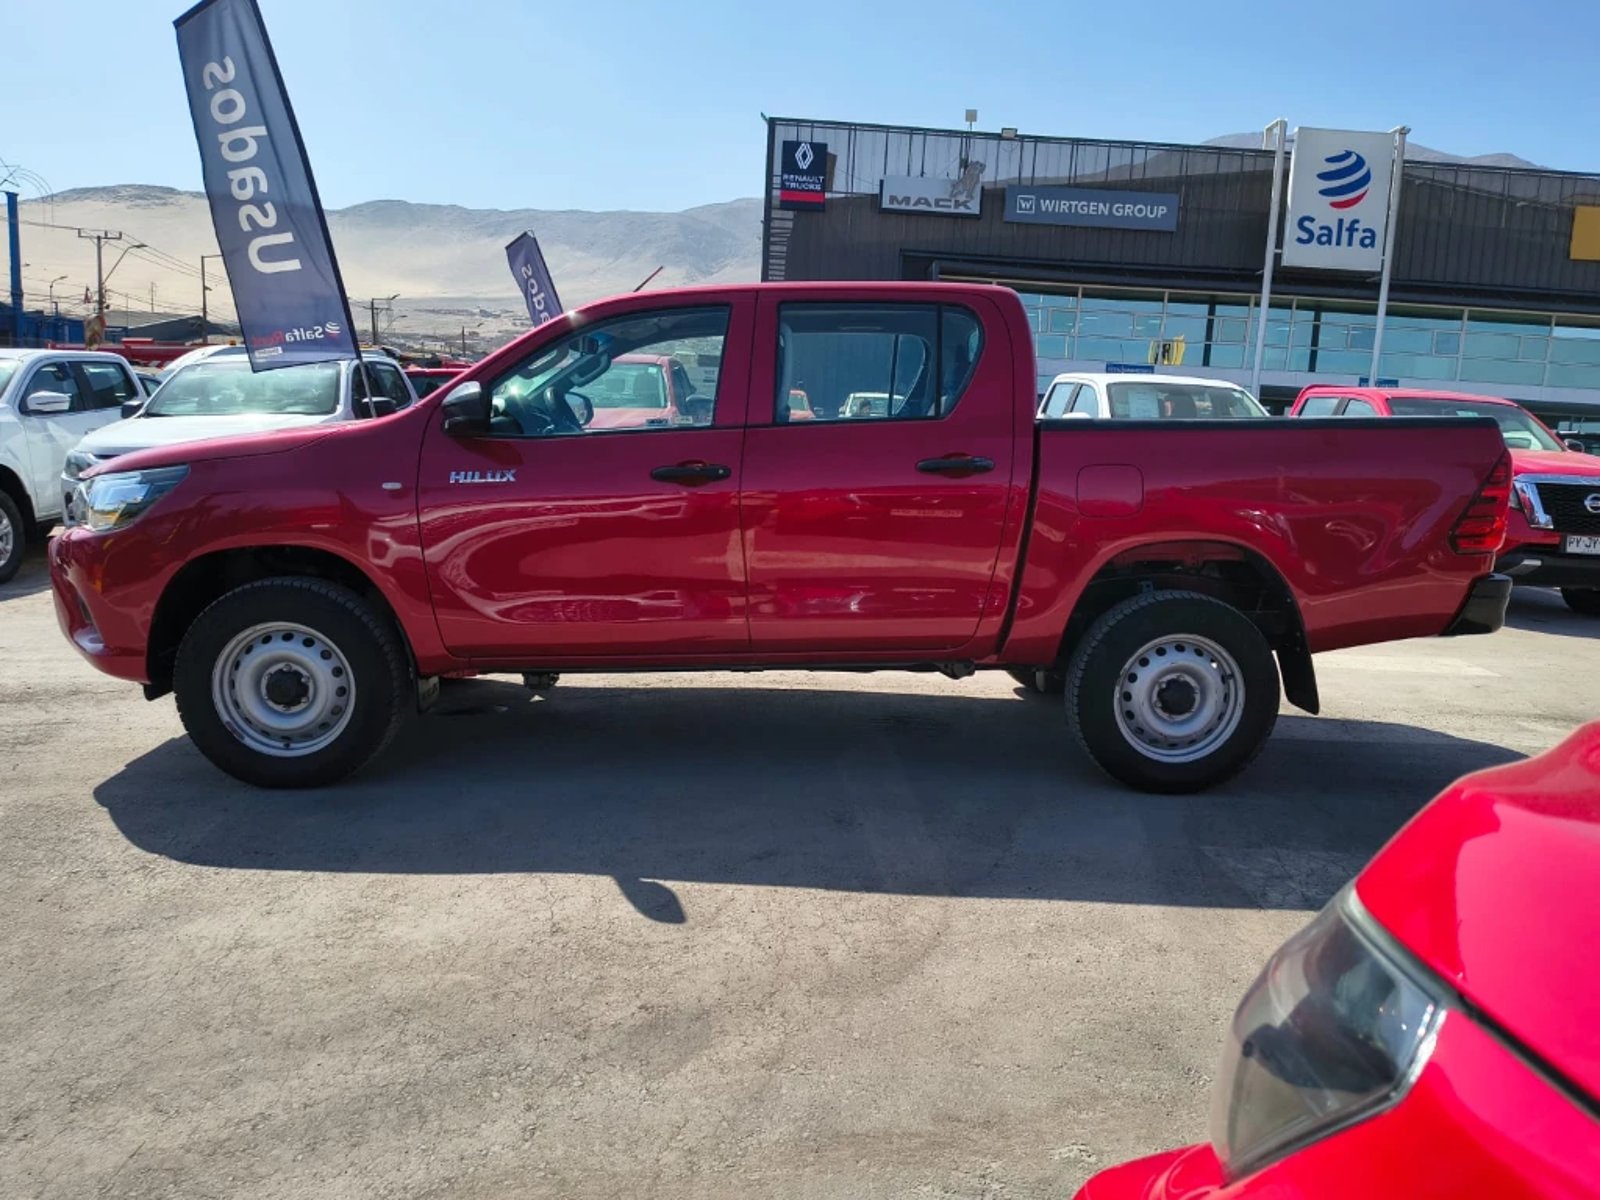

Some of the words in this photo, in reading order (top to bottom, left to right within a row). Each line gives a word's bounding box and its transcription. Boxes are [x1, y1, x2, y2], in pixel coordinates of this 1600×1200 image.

[782, 173, 824, 183] RENAULT
[784, 181, 821, 190] TRUCKS
[888, 194, 972, 210] MACK
[1040, 199, 1110, 216] WIRTGEN
[1112, 204, 1168, 218] GROUP
[1295, 215, 1376, 249] Salfa
[449, 469, 517, 484] HILUX
